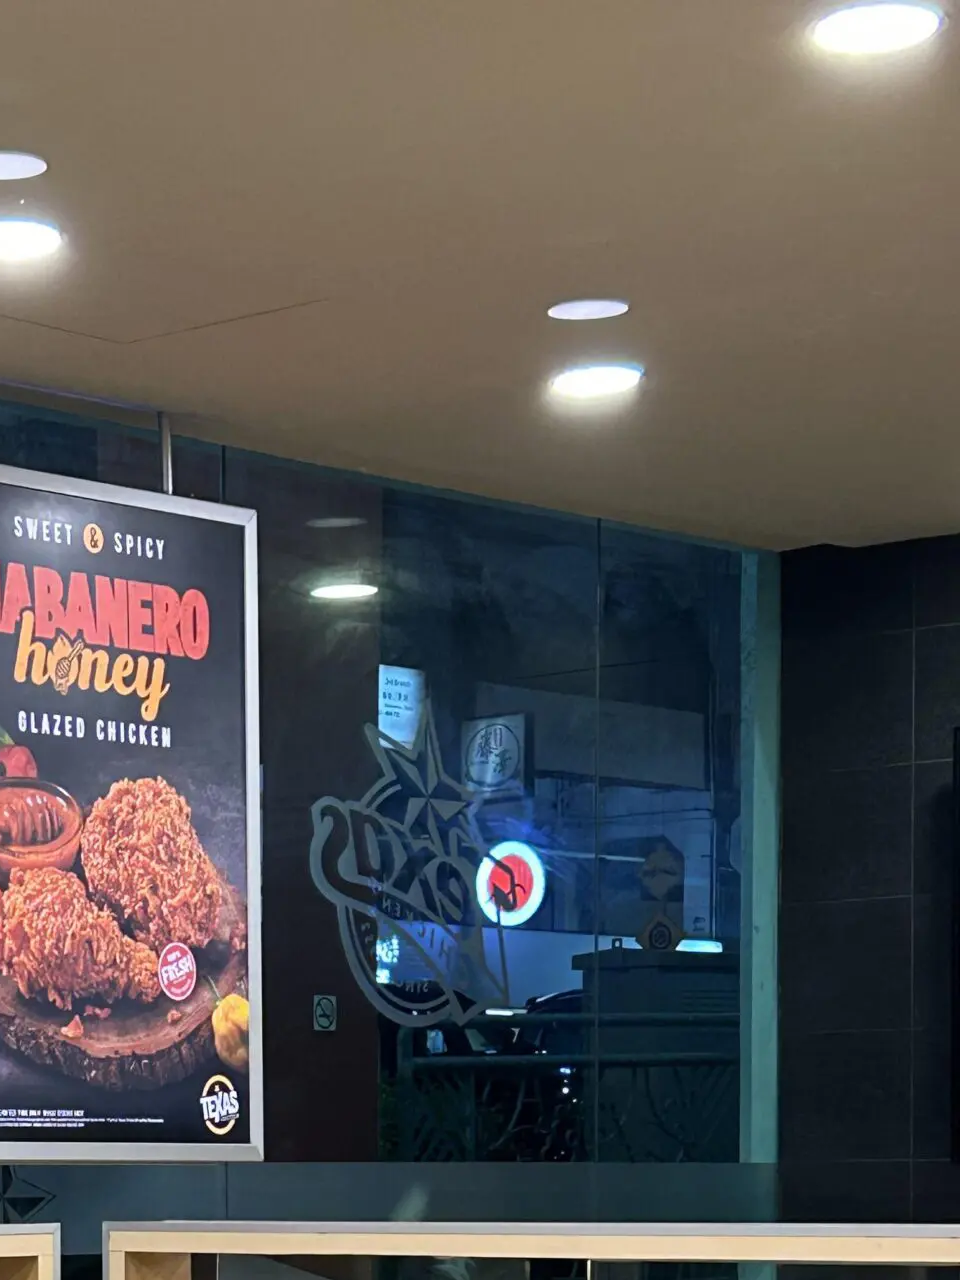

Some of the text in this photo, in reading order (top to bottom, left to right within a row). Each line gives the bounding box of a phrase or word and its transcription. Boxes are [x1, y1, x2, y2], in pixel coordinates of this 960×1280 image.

[14, 515, 73, 546] SWEET
[113, 531, 166, 561] SPICY
[13, 609, 171, 722] honey
[17, 710, 172, 748] GLAZED CHICKEN
[199, 1090, 240, 1122] TEXAS
